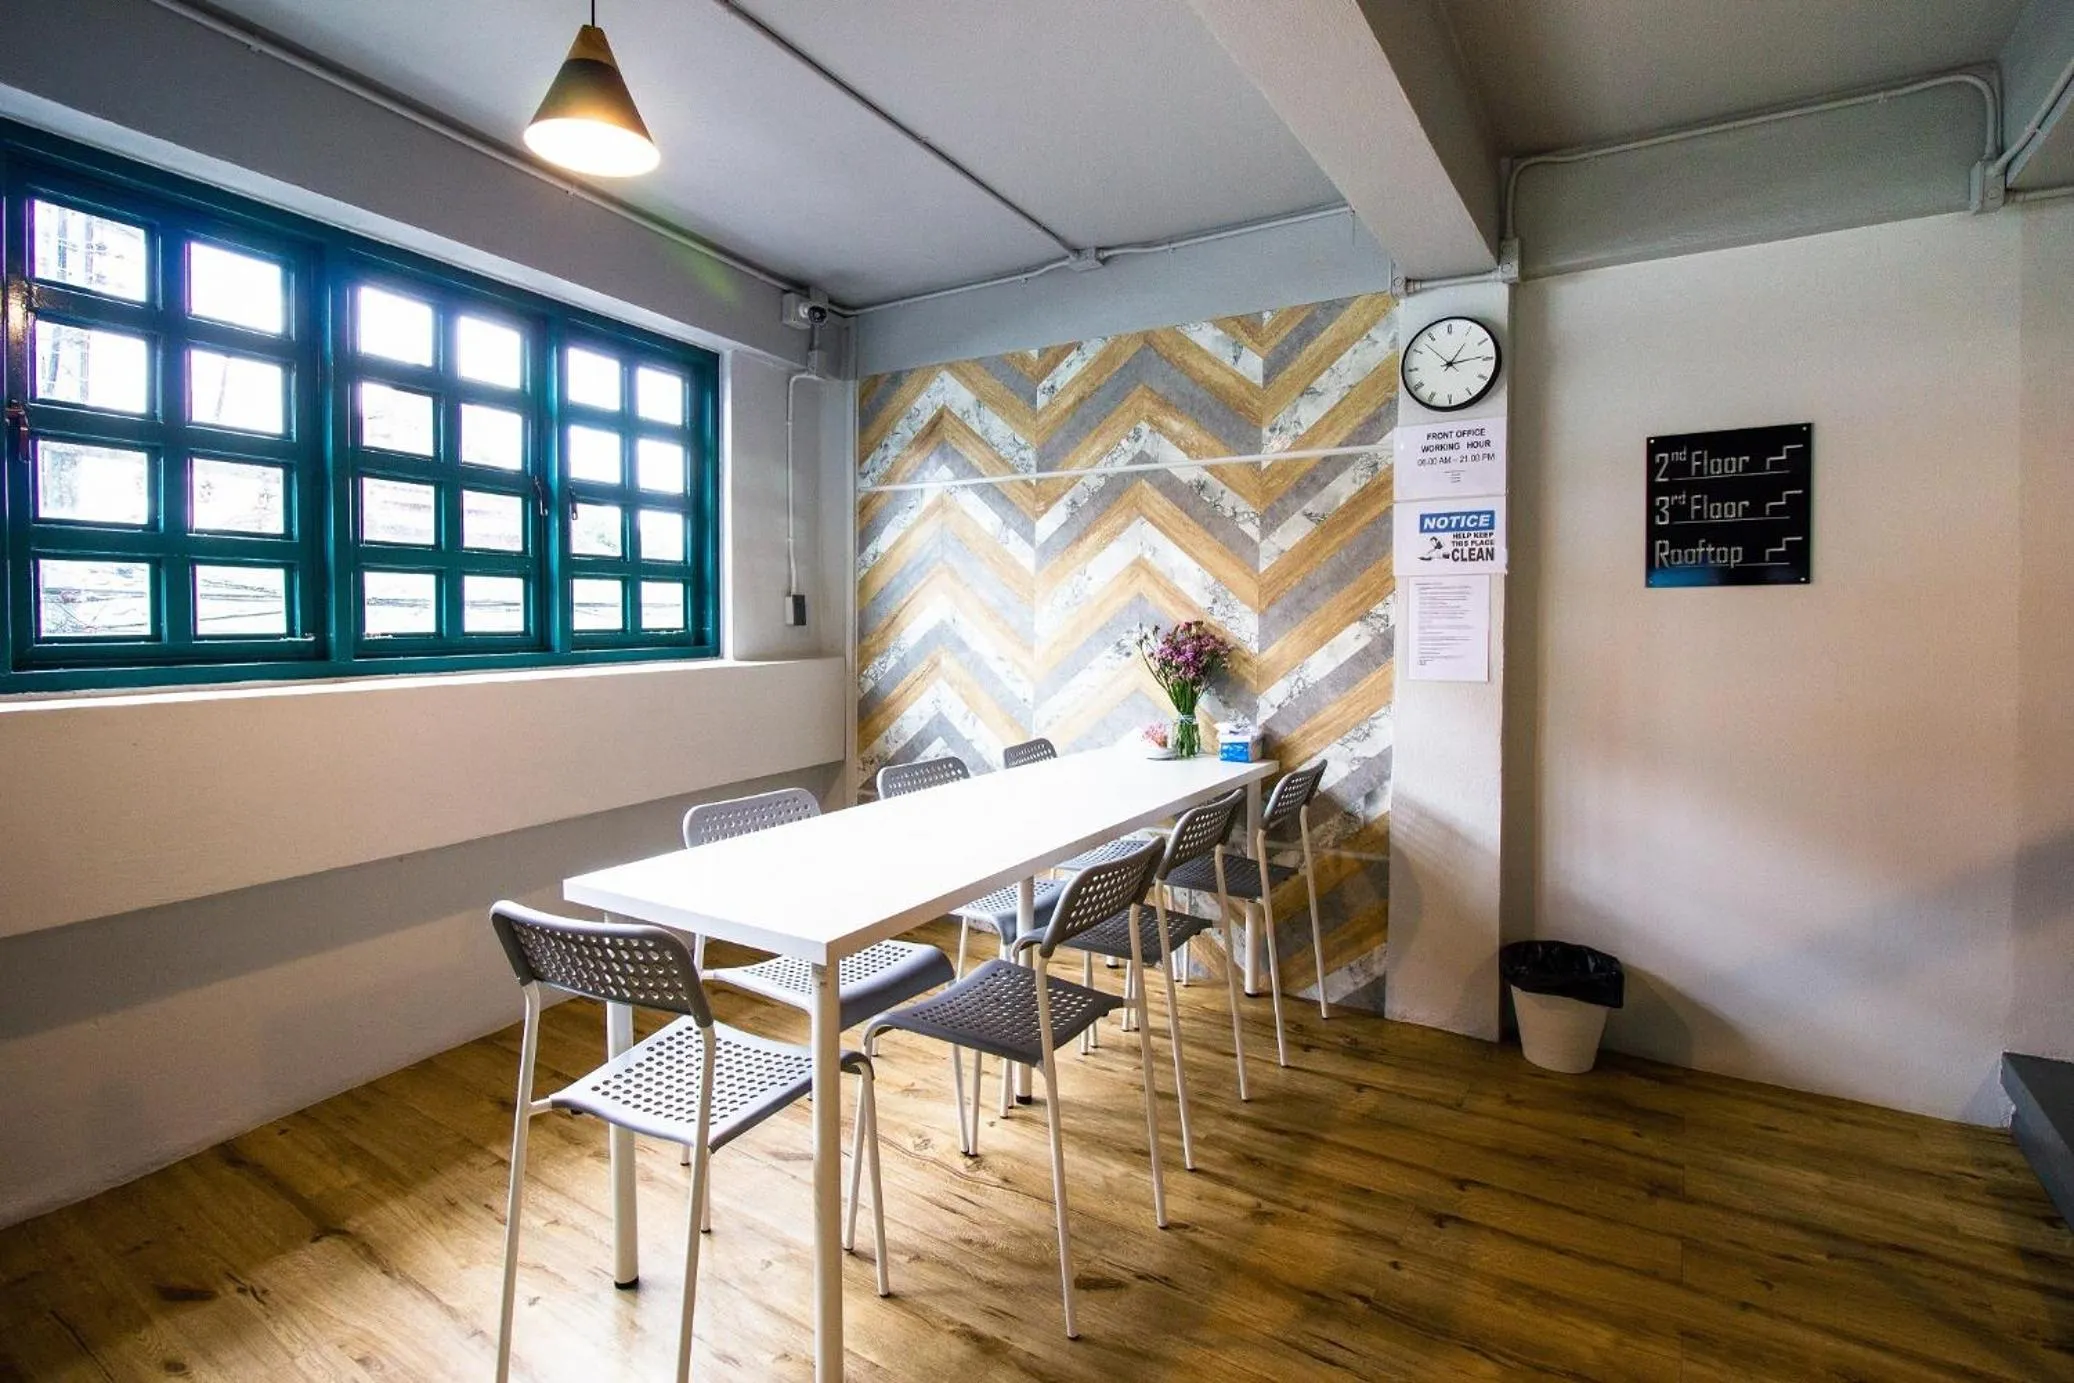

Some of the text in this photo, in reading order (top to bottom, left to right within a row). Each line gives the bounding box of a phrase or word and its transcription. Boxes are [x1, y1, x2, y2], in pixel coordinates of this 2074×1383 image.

[1427, 428, 1486, 440] FRONT OFFICE
[1421, 440, 1491, 453] WORKING HOUR
[1654, 448, 1750, 482] 2nd Floor
[1654, 490, 1750, 525] 3rd Floor
[1424, 514, 1491, 529] NOTICE
[1451, 548, 1494, 562] CLEAN
[1655, 539, 1743, 569] Rooftop
